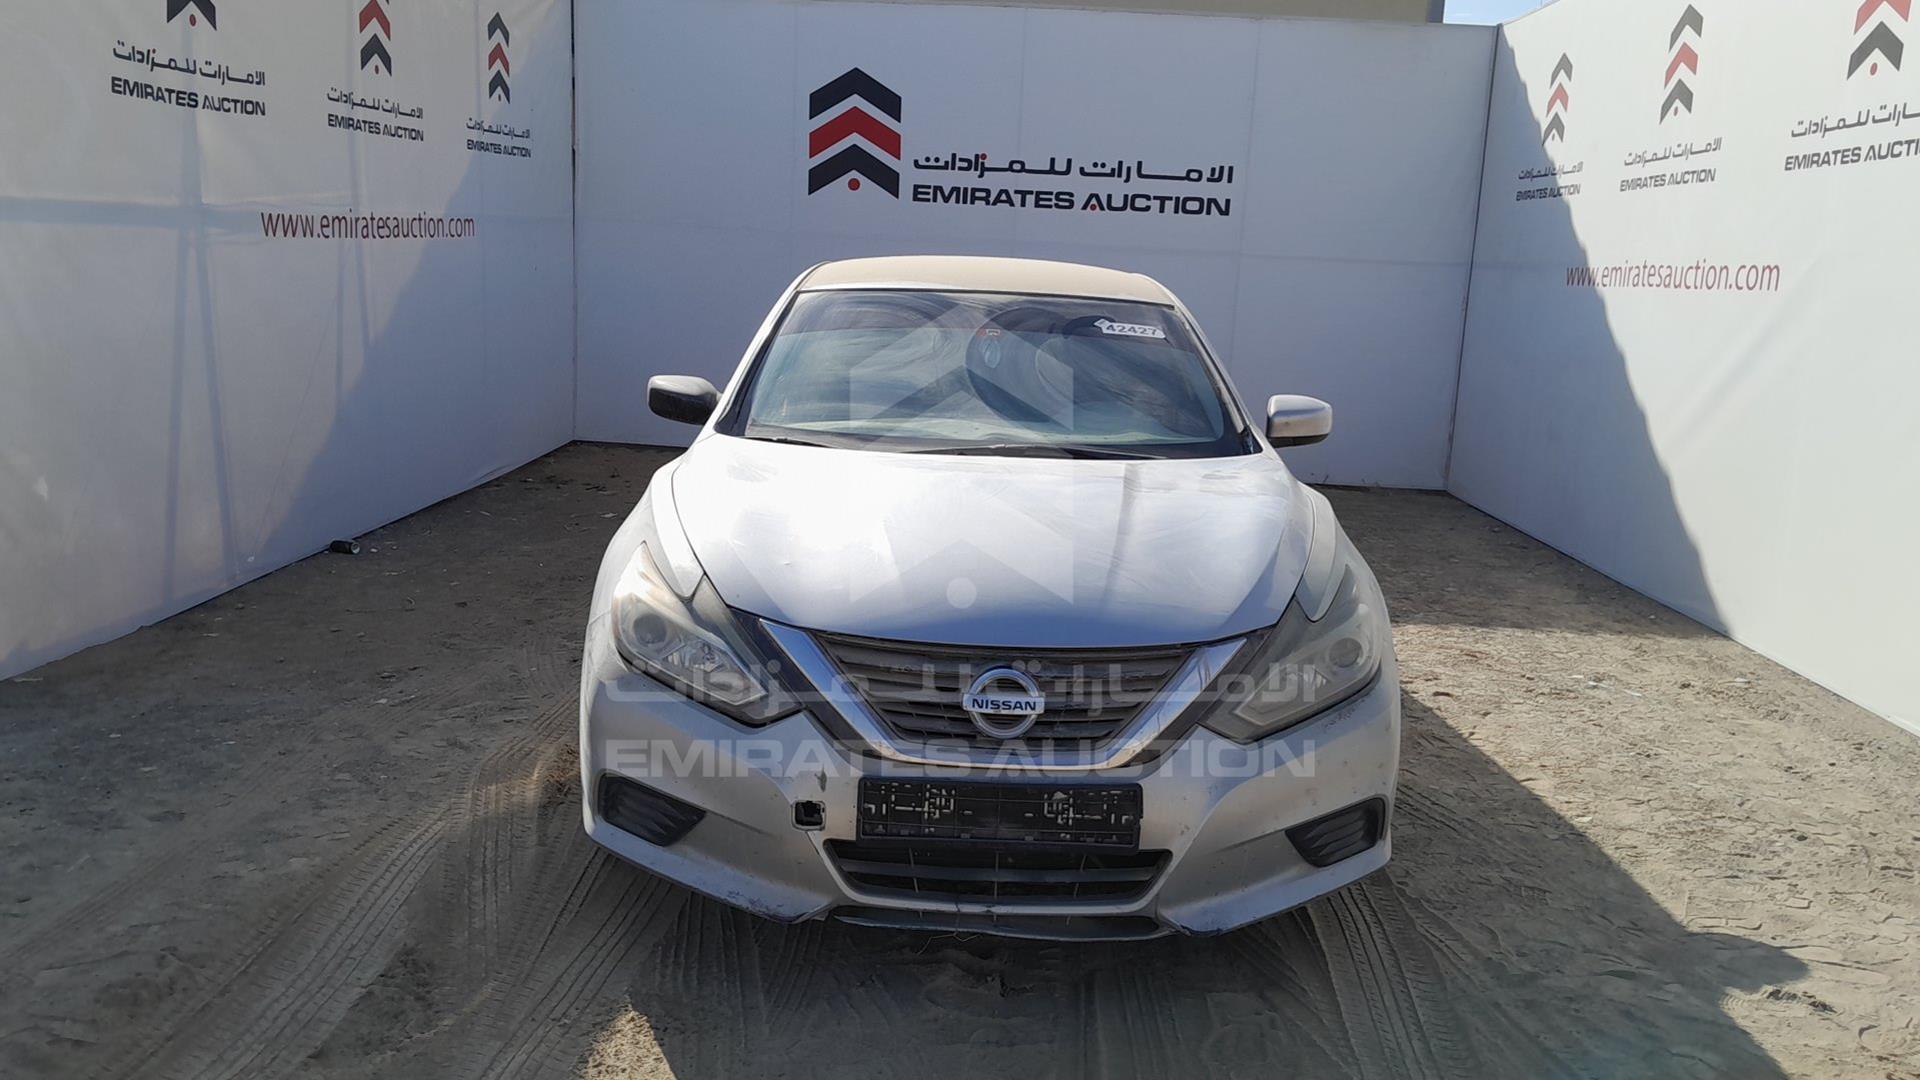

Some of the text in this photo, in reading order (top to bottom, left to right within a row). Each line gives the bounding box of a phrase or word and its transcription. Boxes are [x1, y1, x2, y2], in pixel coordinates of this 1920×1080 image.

[111, 76, 266, 116] EMIRATES AUCTION
[327, 112, 424, 142] EMIRATES AUCTION
[466, 138, 531, 158] EMIRATES AUCTION
[1784, 138, 1920, 171] EMIRATES AUCTI
[913, 152, 1234, 183] الامارات للمزادات
[1619, 168, 1716, 192] EMIRATES AUCTION
[911, 184, 1232, 216] EMIRATES AUCTION
[261, 208, 475, 239] www.emiratesauction.com
[1565, 258, 1780, 292] www.emiratesauction.com
[1106, 324, 1157, 336] 42427
[971, 698, 1037, 711] NISSAN
